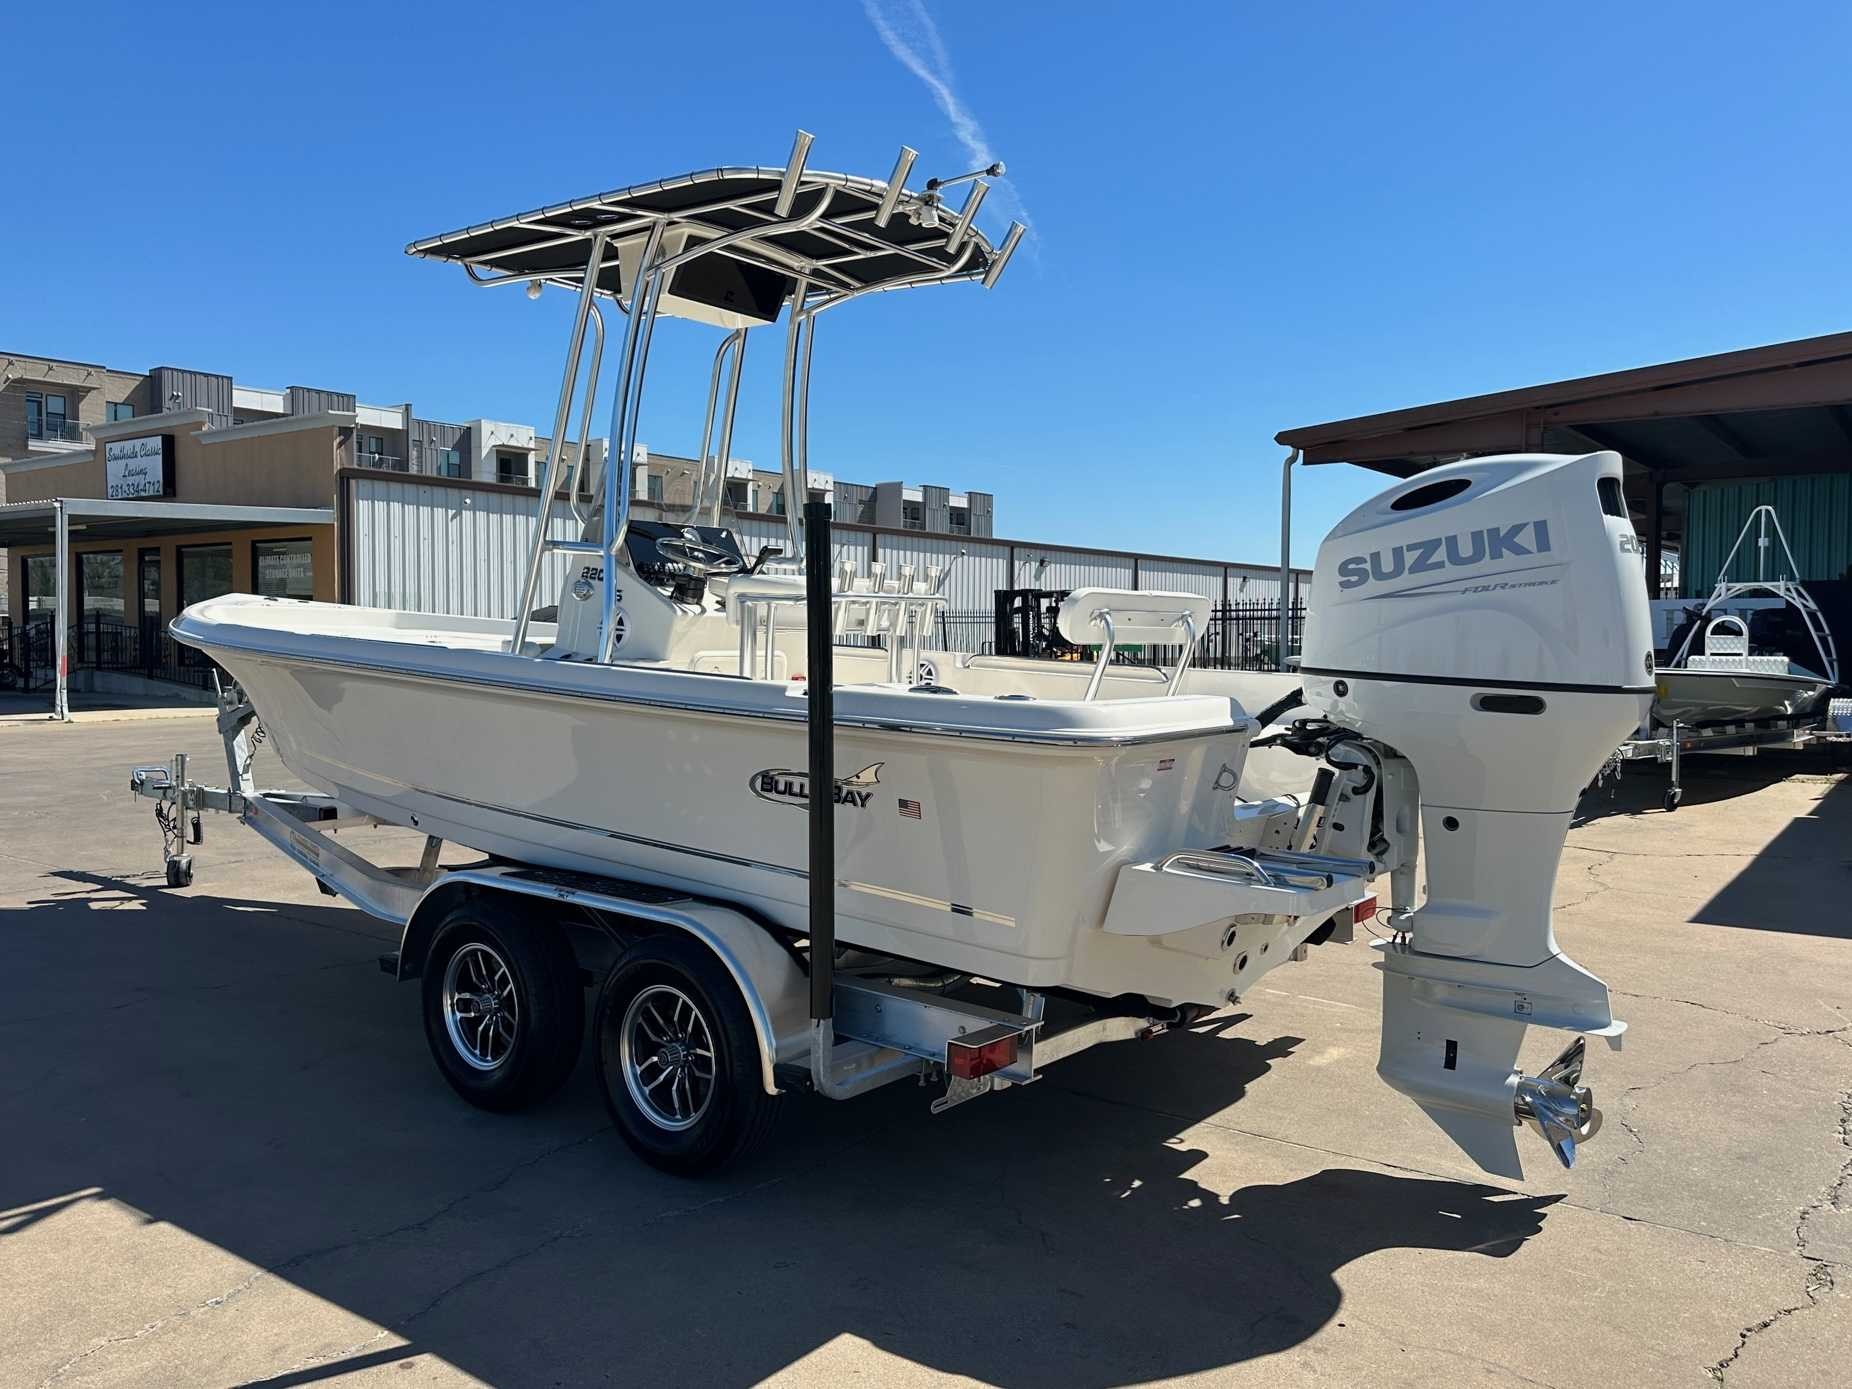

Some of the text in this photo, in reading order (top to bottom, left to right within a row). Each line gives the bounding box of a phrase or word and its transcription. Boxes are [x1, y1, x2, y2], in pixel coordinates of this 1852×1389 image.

[110, 480, 161, 498] 281-334-4712
[1337, 519, 1552, 590] SUZUKI
[760, 774, 809, 799] BULL
